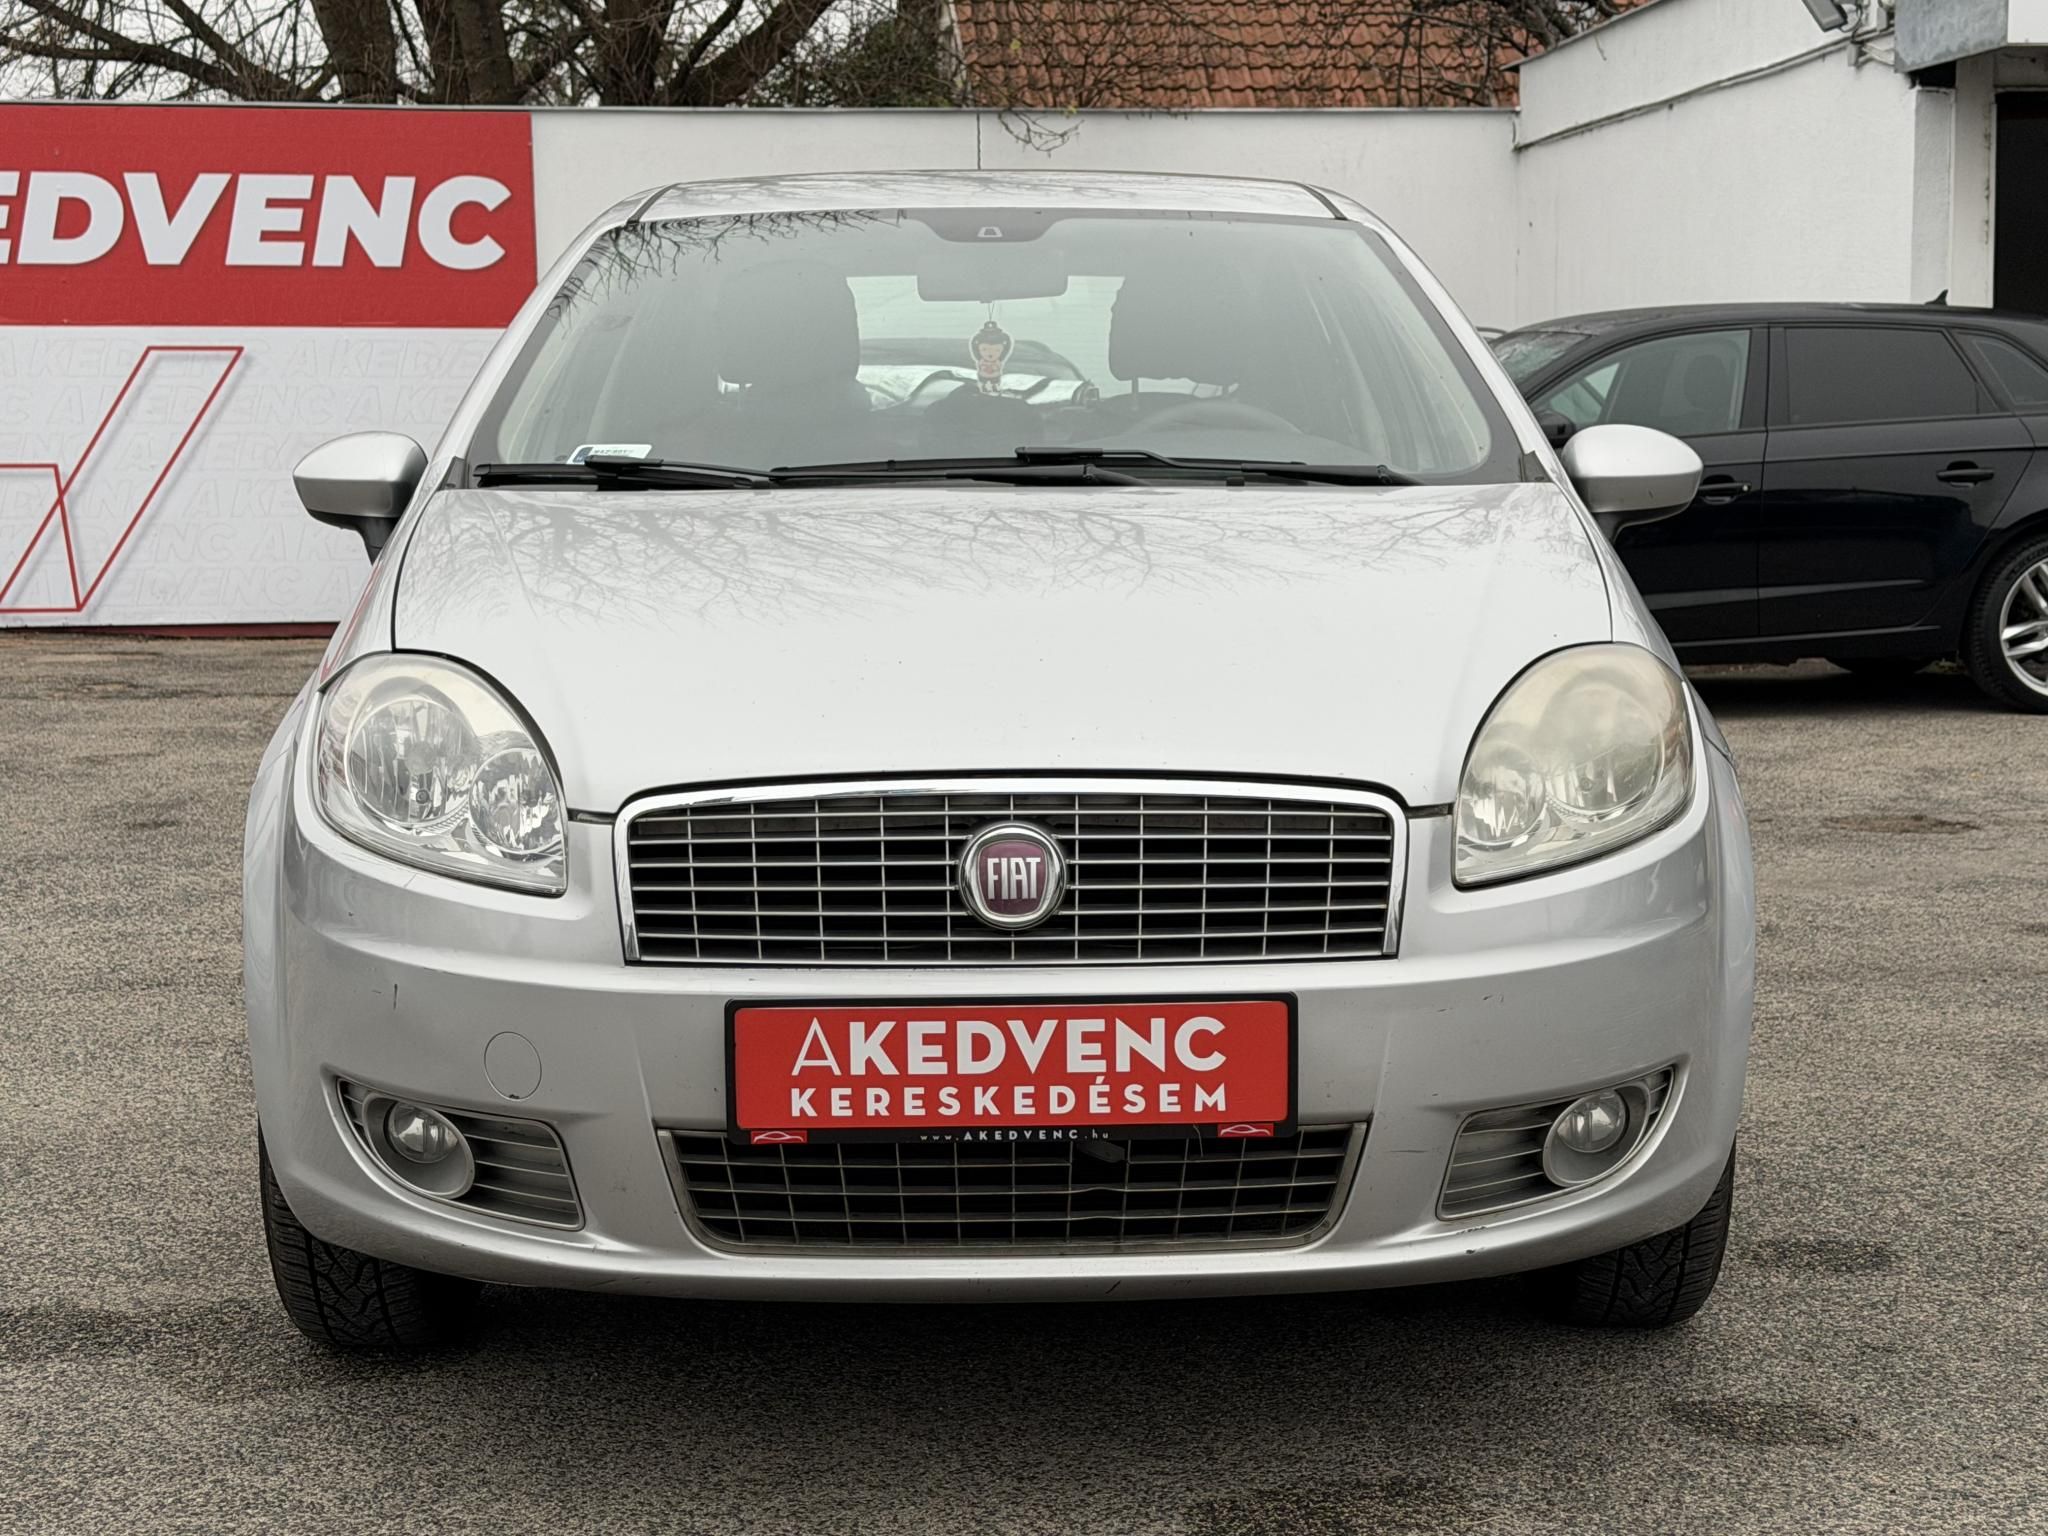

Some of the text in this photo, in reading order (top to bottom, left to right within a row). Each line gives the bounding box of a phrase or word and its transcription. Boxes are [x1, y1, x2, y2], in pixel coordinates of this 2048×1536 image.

[0, 170, 512, 271] DVENC
[987, 857, 1041, 900] FIAT
[790, 1016, 1228, 1076] AKEDVENC
[790, 1076, 1227, 1117] KERESKEDÉSEM
[919, 1128, 1110, 1142] www.AKEDVENC.hu
